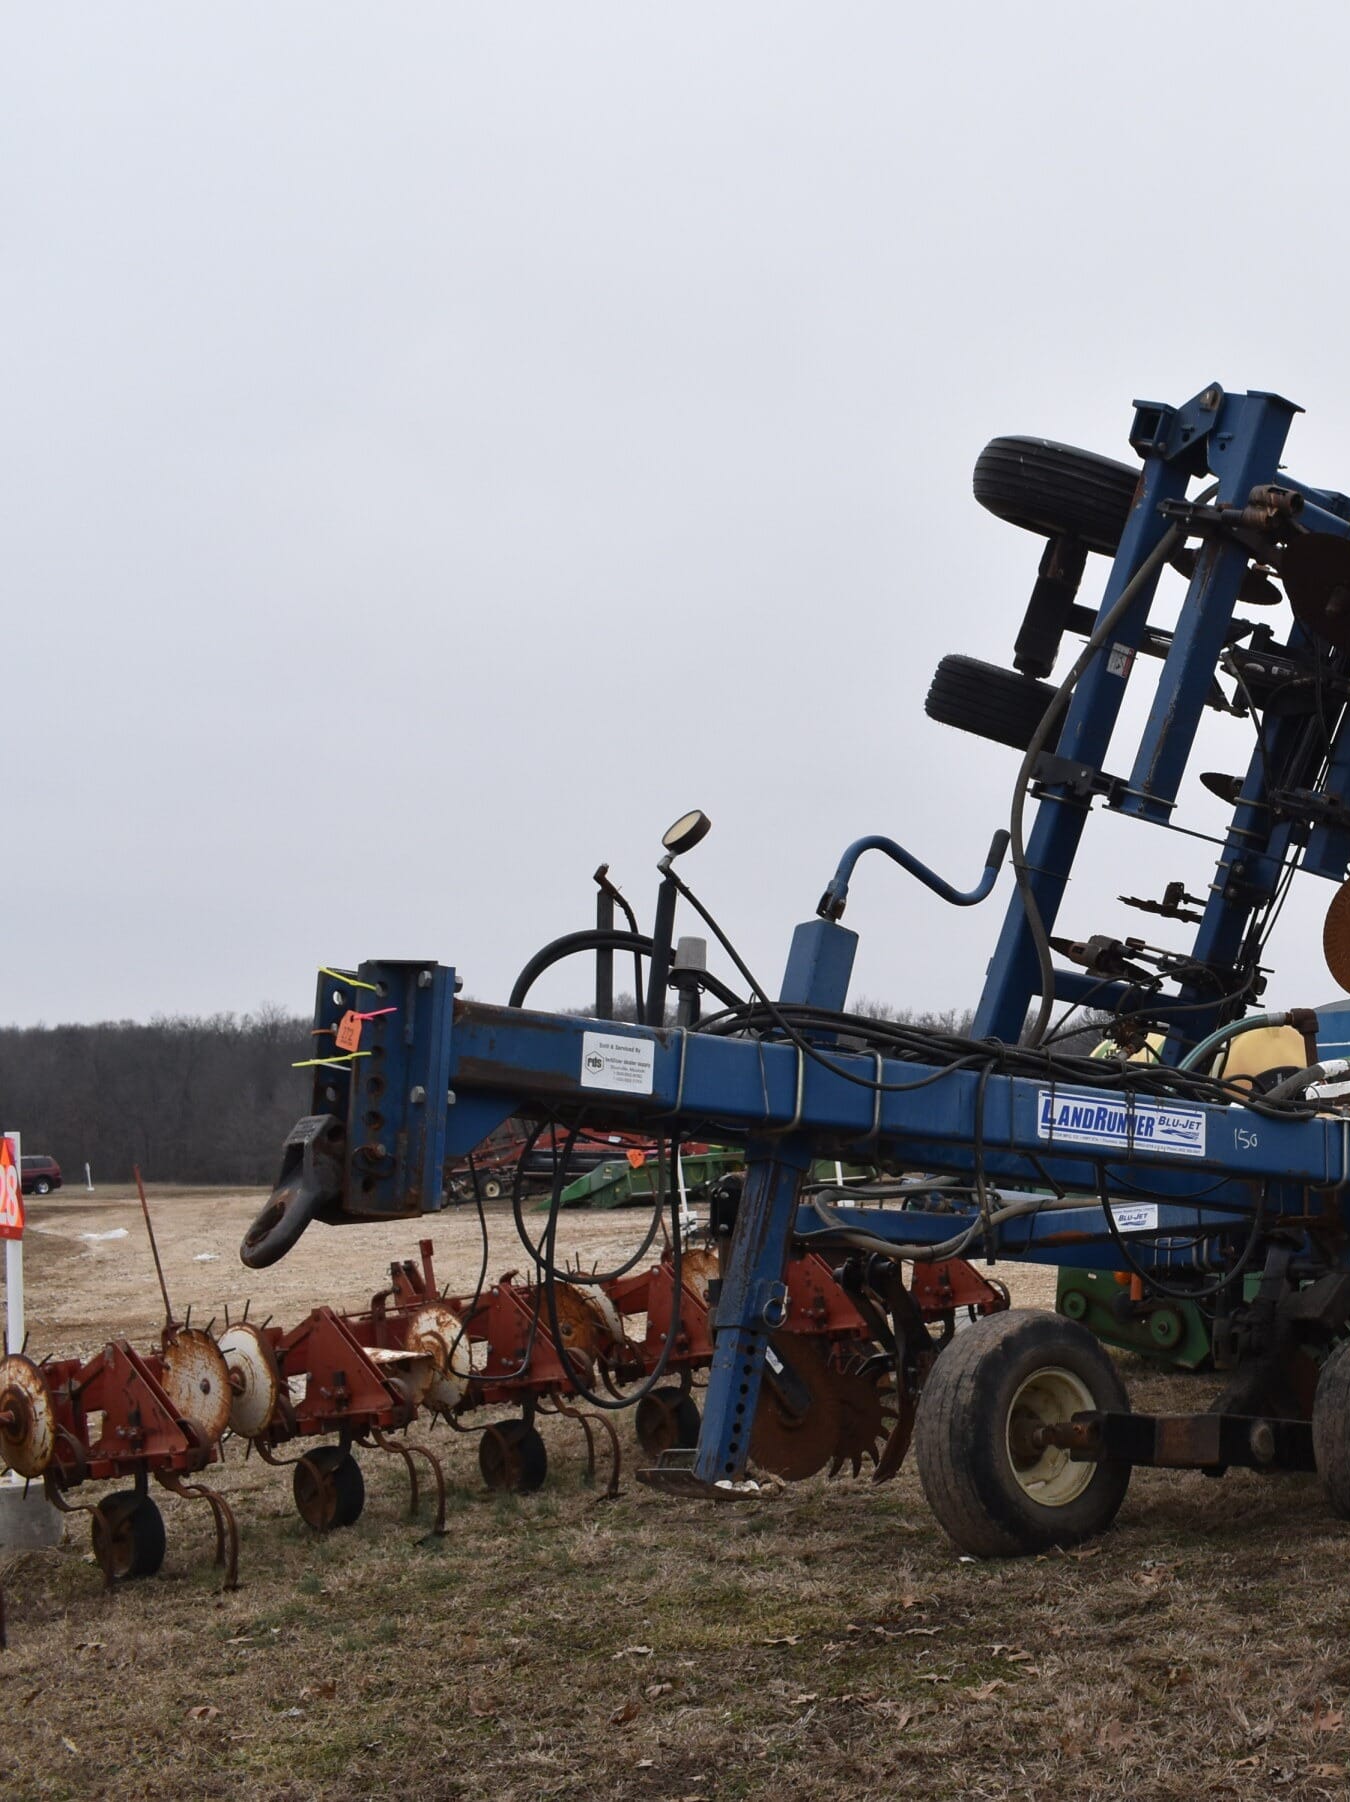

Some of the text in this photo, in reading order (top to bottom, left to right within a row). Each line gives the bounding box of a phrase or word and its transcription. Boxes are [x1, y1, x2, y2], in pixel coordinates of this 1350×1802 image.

[1158, 1115, 1202, 1131] BLU-JET
[1234, 1127, 1258, 1150] 150
[1118, 1212, 1148, 1222] BLU-JET
